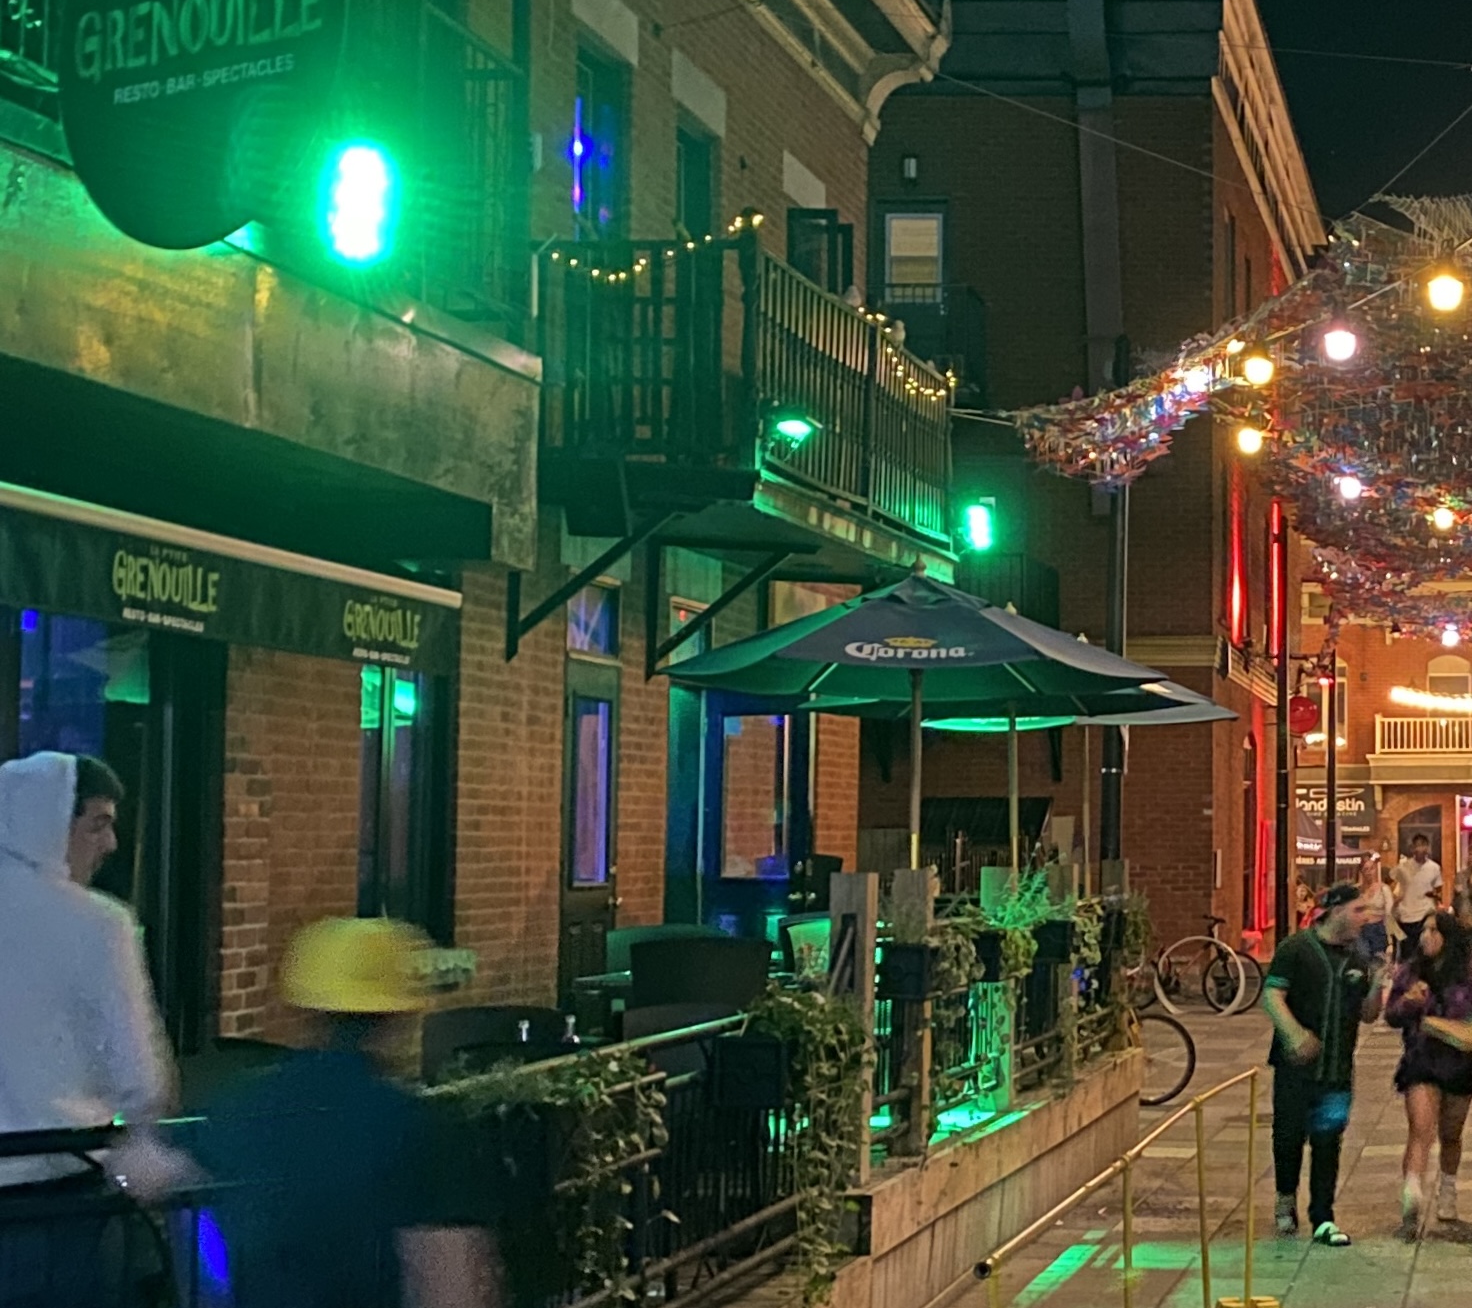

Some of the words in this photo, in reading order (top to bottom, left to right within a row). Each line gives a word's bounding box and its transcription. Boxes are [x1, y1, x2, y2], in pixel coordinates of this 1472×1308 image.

[112, 549, 220, 613] GRENOUILLE
[343, 599, 421, 650] GRENOUILLE
[844, 641, 967, 661] Corona
